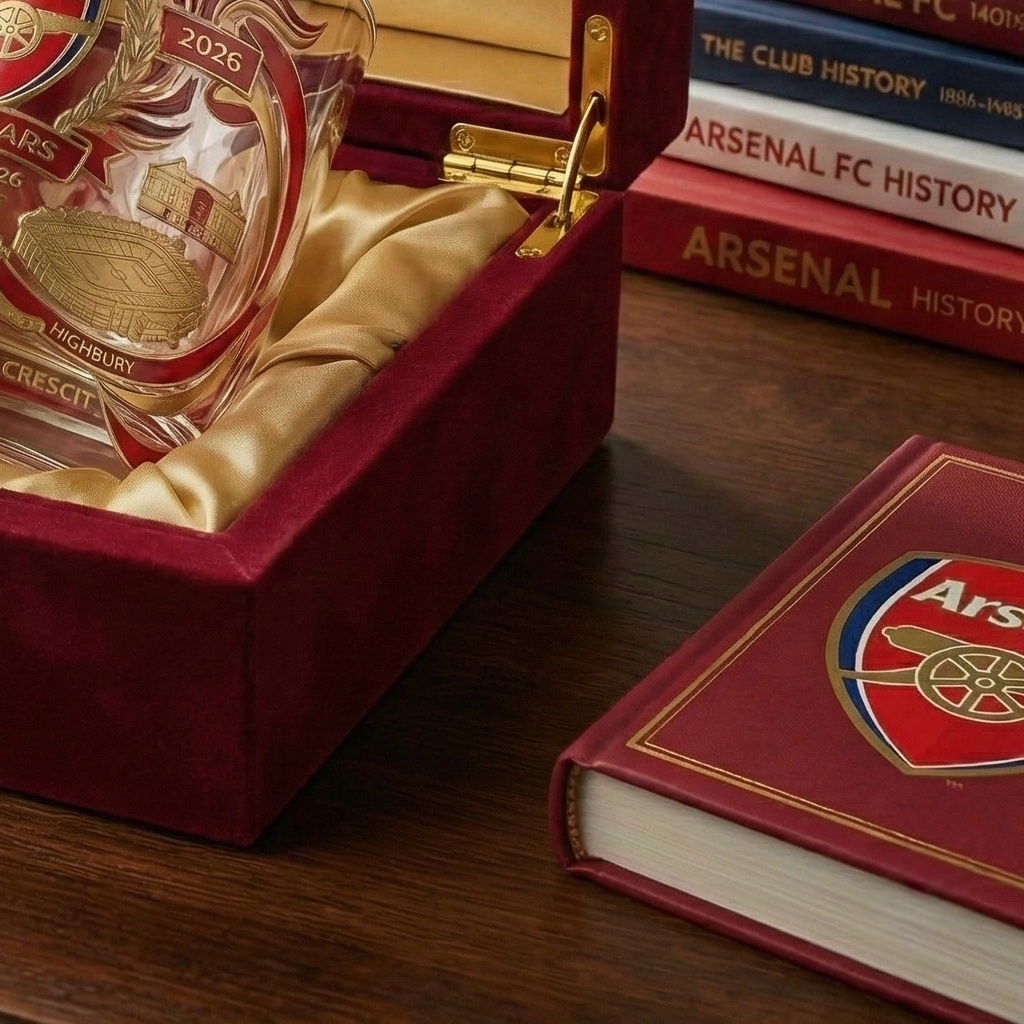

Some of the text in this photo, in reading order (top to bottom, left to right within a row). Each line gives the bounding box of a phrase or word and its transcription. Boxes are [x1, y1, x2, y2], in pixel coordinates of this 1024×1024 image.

[177, 26, 243, 73] 2026
[701, 32, 744, 62] THE
[752, 44, 814, 76] CLUB
[821, 58, 926, 101] HISTORY
[685, 116, 1018, 224] ARSENAL FC HISTORY
[681, 225, 1024, 335] ARSENAL HISTORY
[49, 321, 136, 375] HIGHBURY
[2, 359, 96, 410] CRESCIT
[910, 578, 1024, 629] Ars
